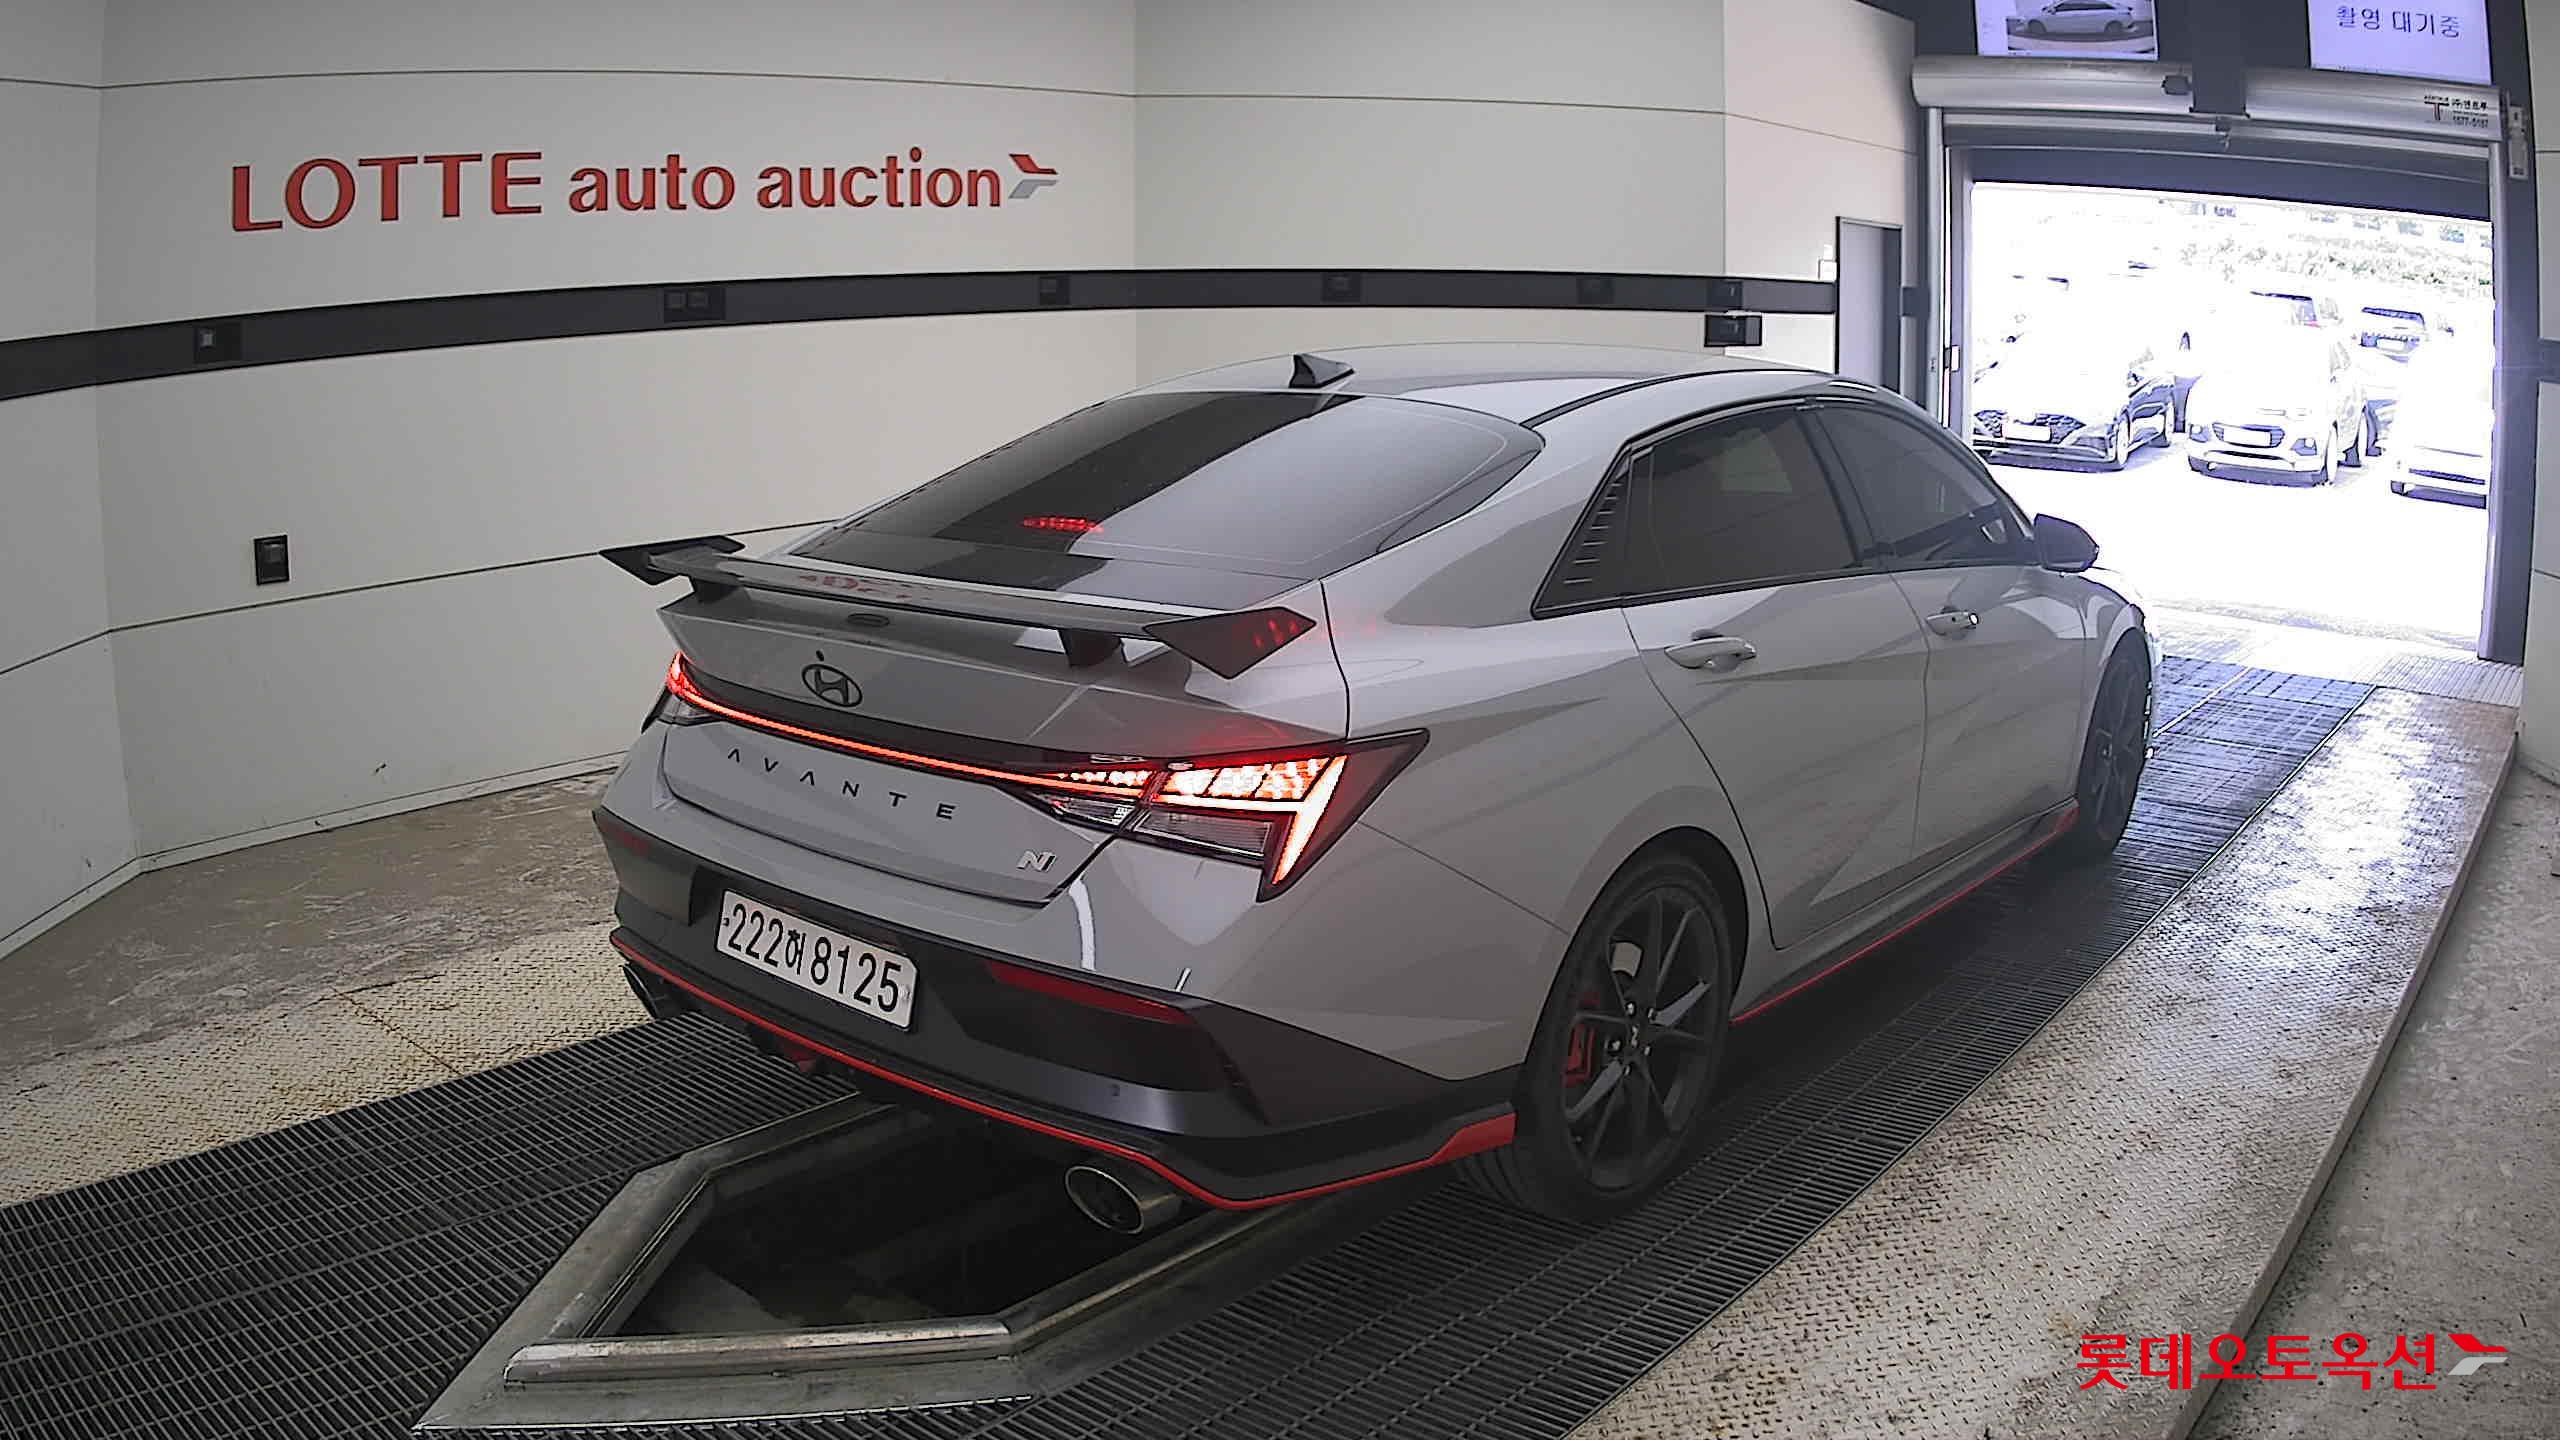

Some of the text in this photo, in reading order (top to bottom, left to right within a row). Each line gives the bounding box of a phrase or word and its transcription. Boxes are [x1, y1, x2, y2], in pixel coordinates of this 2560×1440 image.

[2337, 6, 2460, 38] 촬영 대기중
[232, 146, 1002, 232] LOTTE auto auction
[727, 748, 957, 820] AVANTE
[1016, 850, 1057, 873] N
